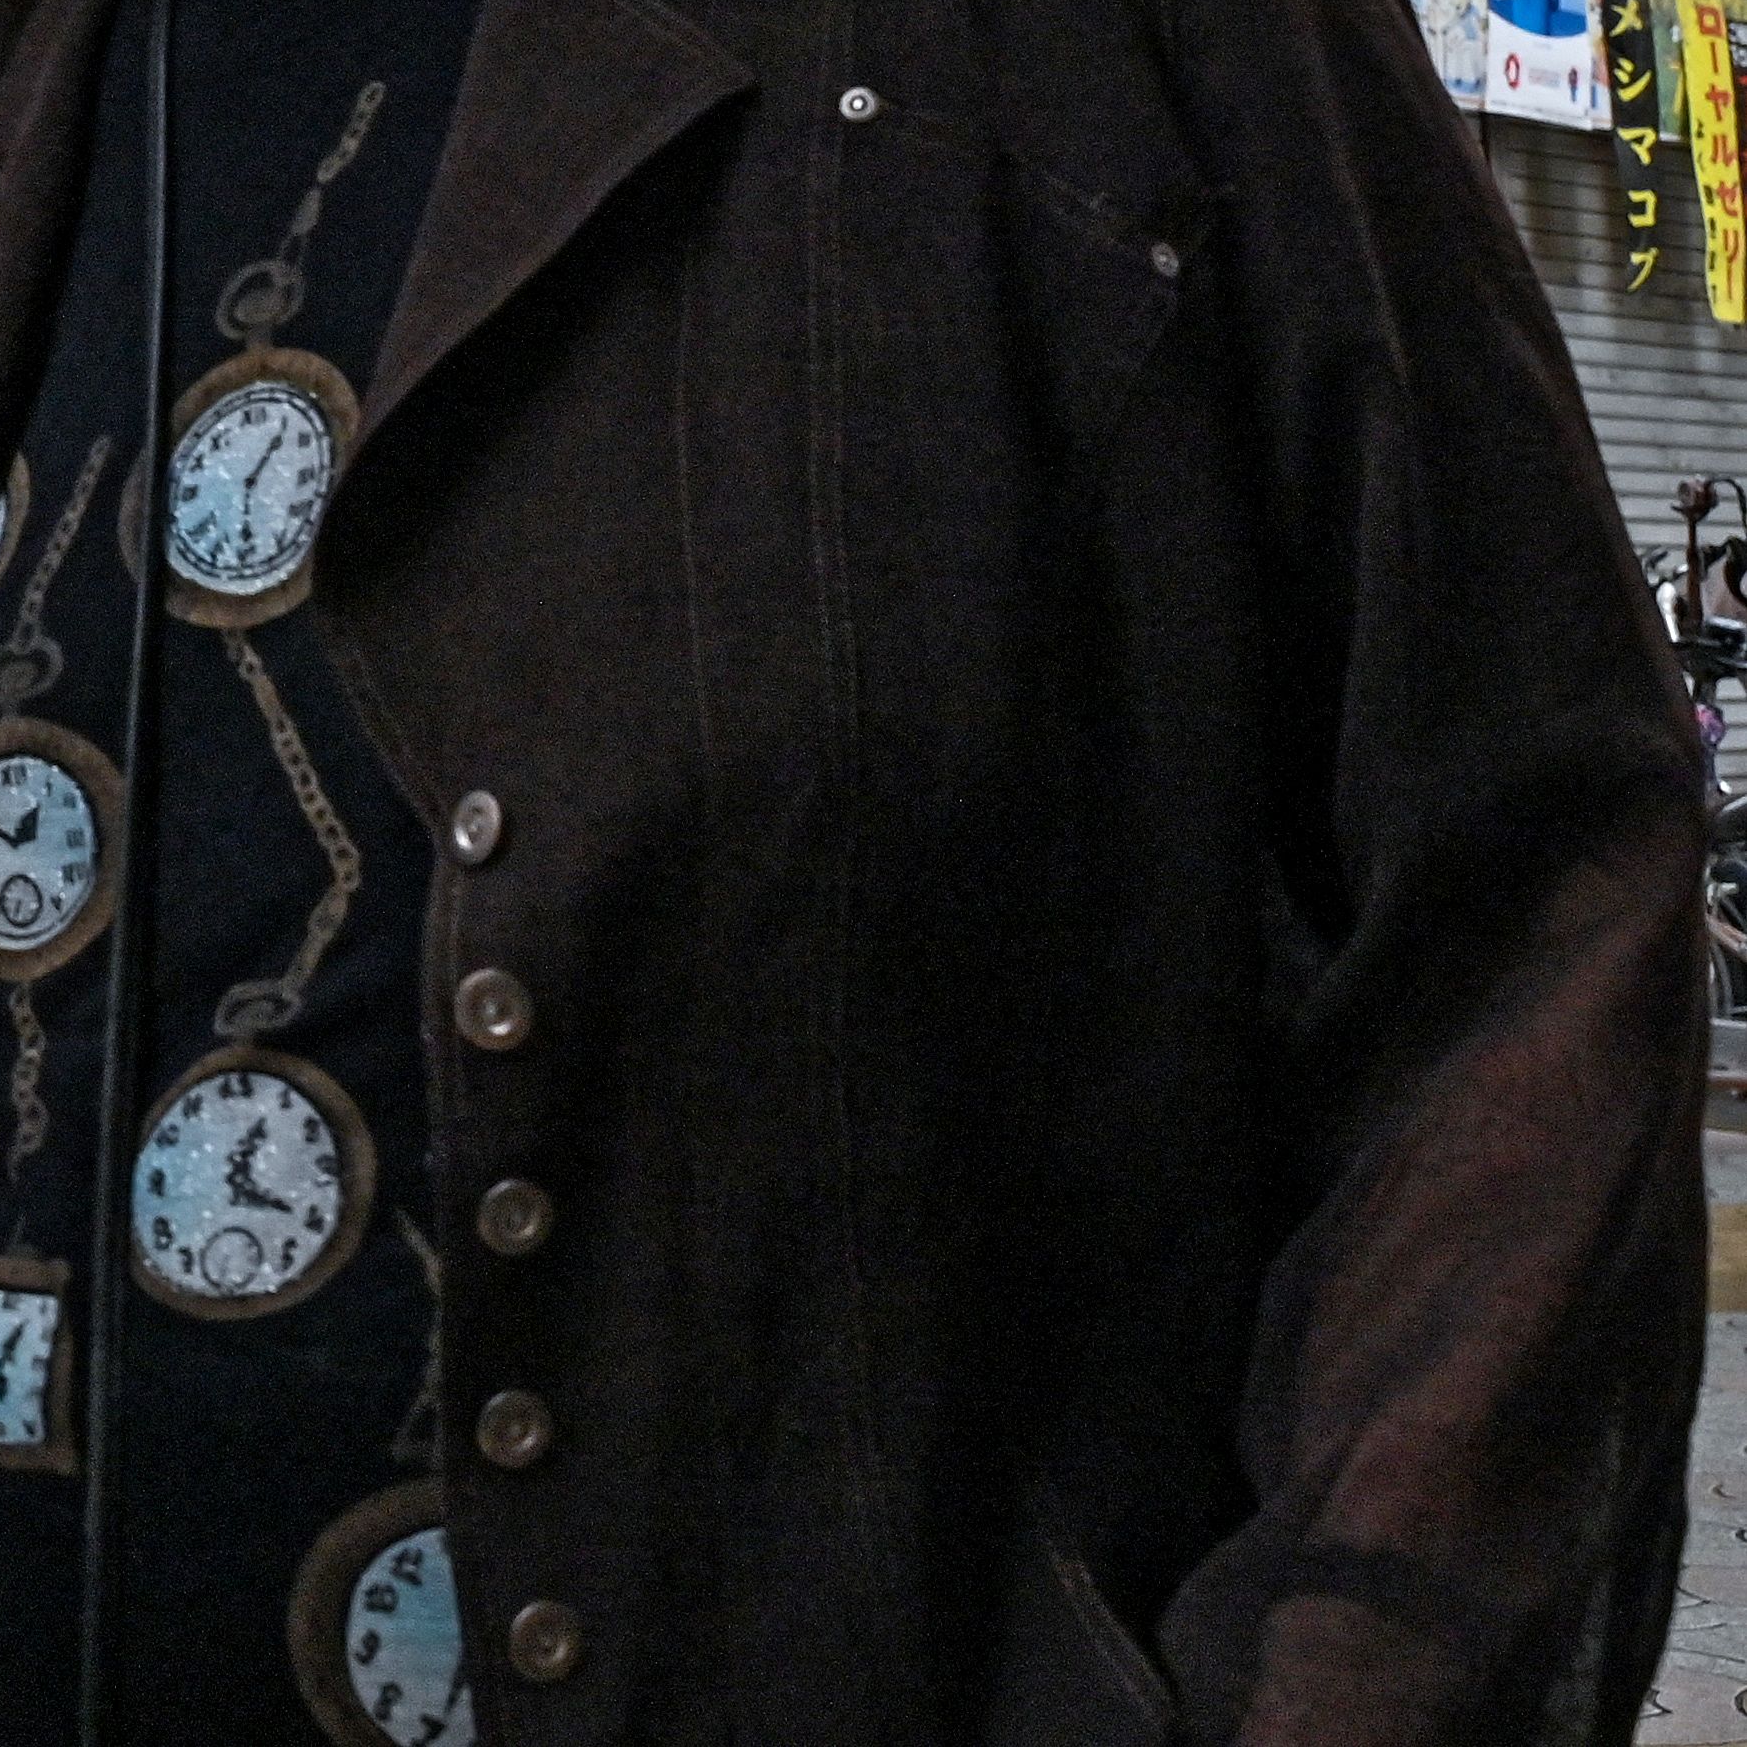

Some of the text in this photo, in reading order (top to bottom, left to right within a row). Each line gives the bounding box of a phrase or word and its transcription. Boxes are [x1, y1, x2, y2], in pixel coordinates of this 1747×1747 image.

[1694, 5, 1741, 300] ローヤルゼリー
